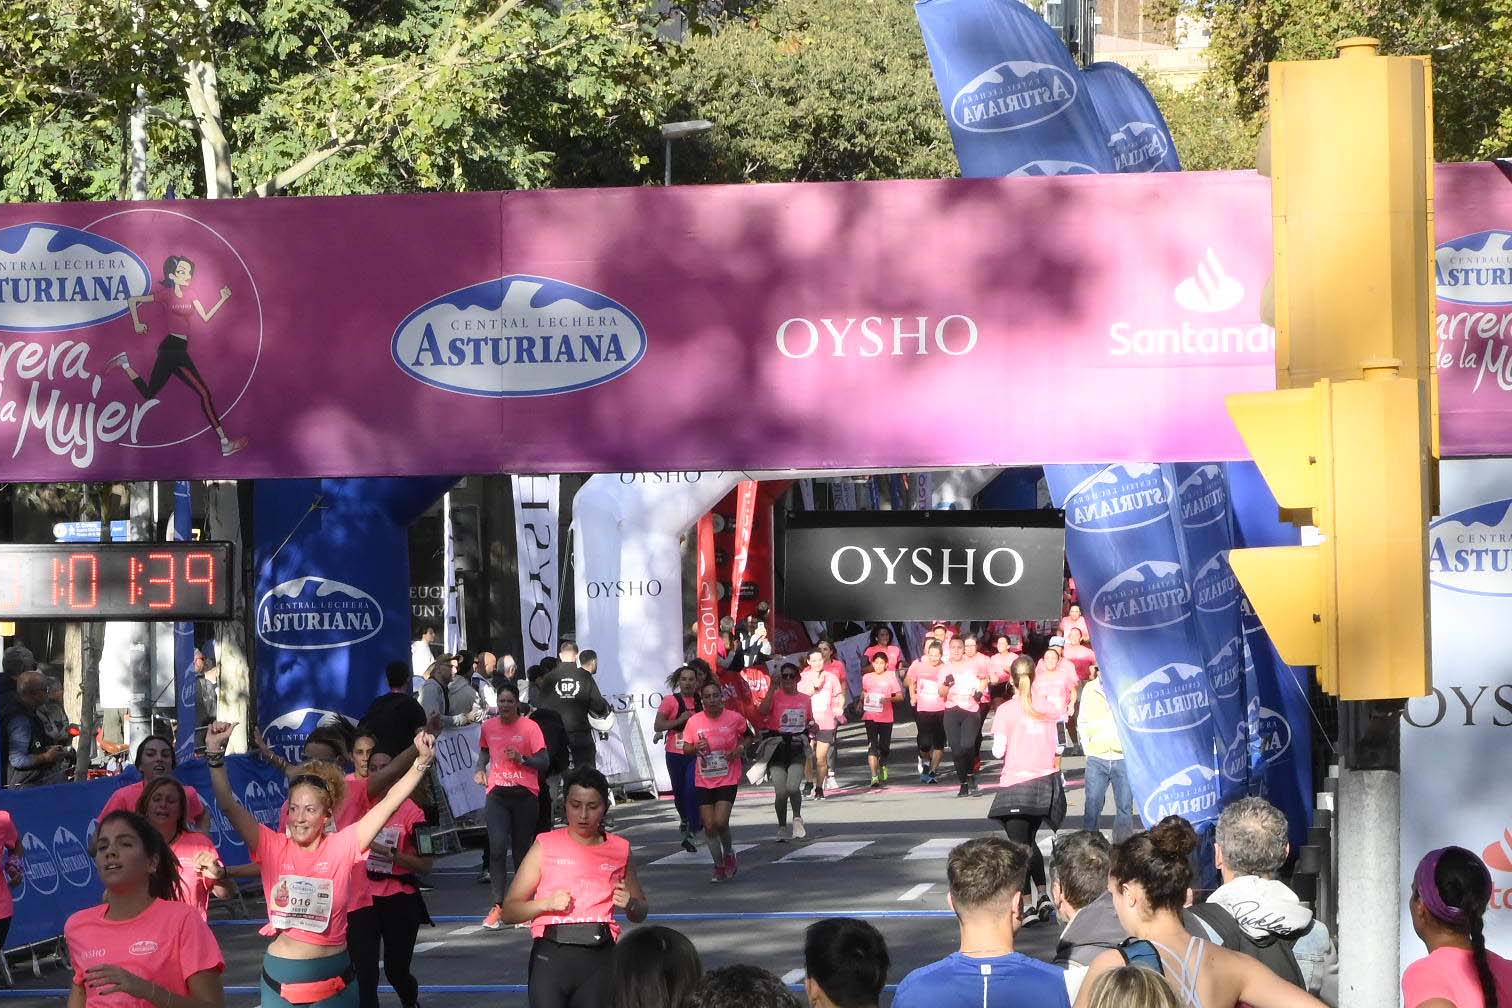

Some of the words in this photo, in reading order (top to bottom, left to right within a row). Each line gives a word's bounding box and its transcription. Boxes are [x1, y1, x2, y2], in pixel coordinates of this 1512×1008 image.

[53, 259, 126, 270] LECHERA
[451, 318, 529, 331] CENTRAL
[538, 316, 618, 327] LECHERA
[411, 321, 627, 367] ASTURIANA
[775, 313, 979, 358] OYSHO
[1460, 341, 1477, 369] la
[12, 373, 161, 469] Mujer
[830, 545, 1024, 586] OYSHO
[586, 579, 662, 600] OYSHO
[274, 602, 315, 610] CENTRAL
[261, 606, 374, 634] ASTURIANA
[561, 682, 575, 692] BP
[275, 733, 310, 742] CENTRA
[290, 897, 311, 907] 016
